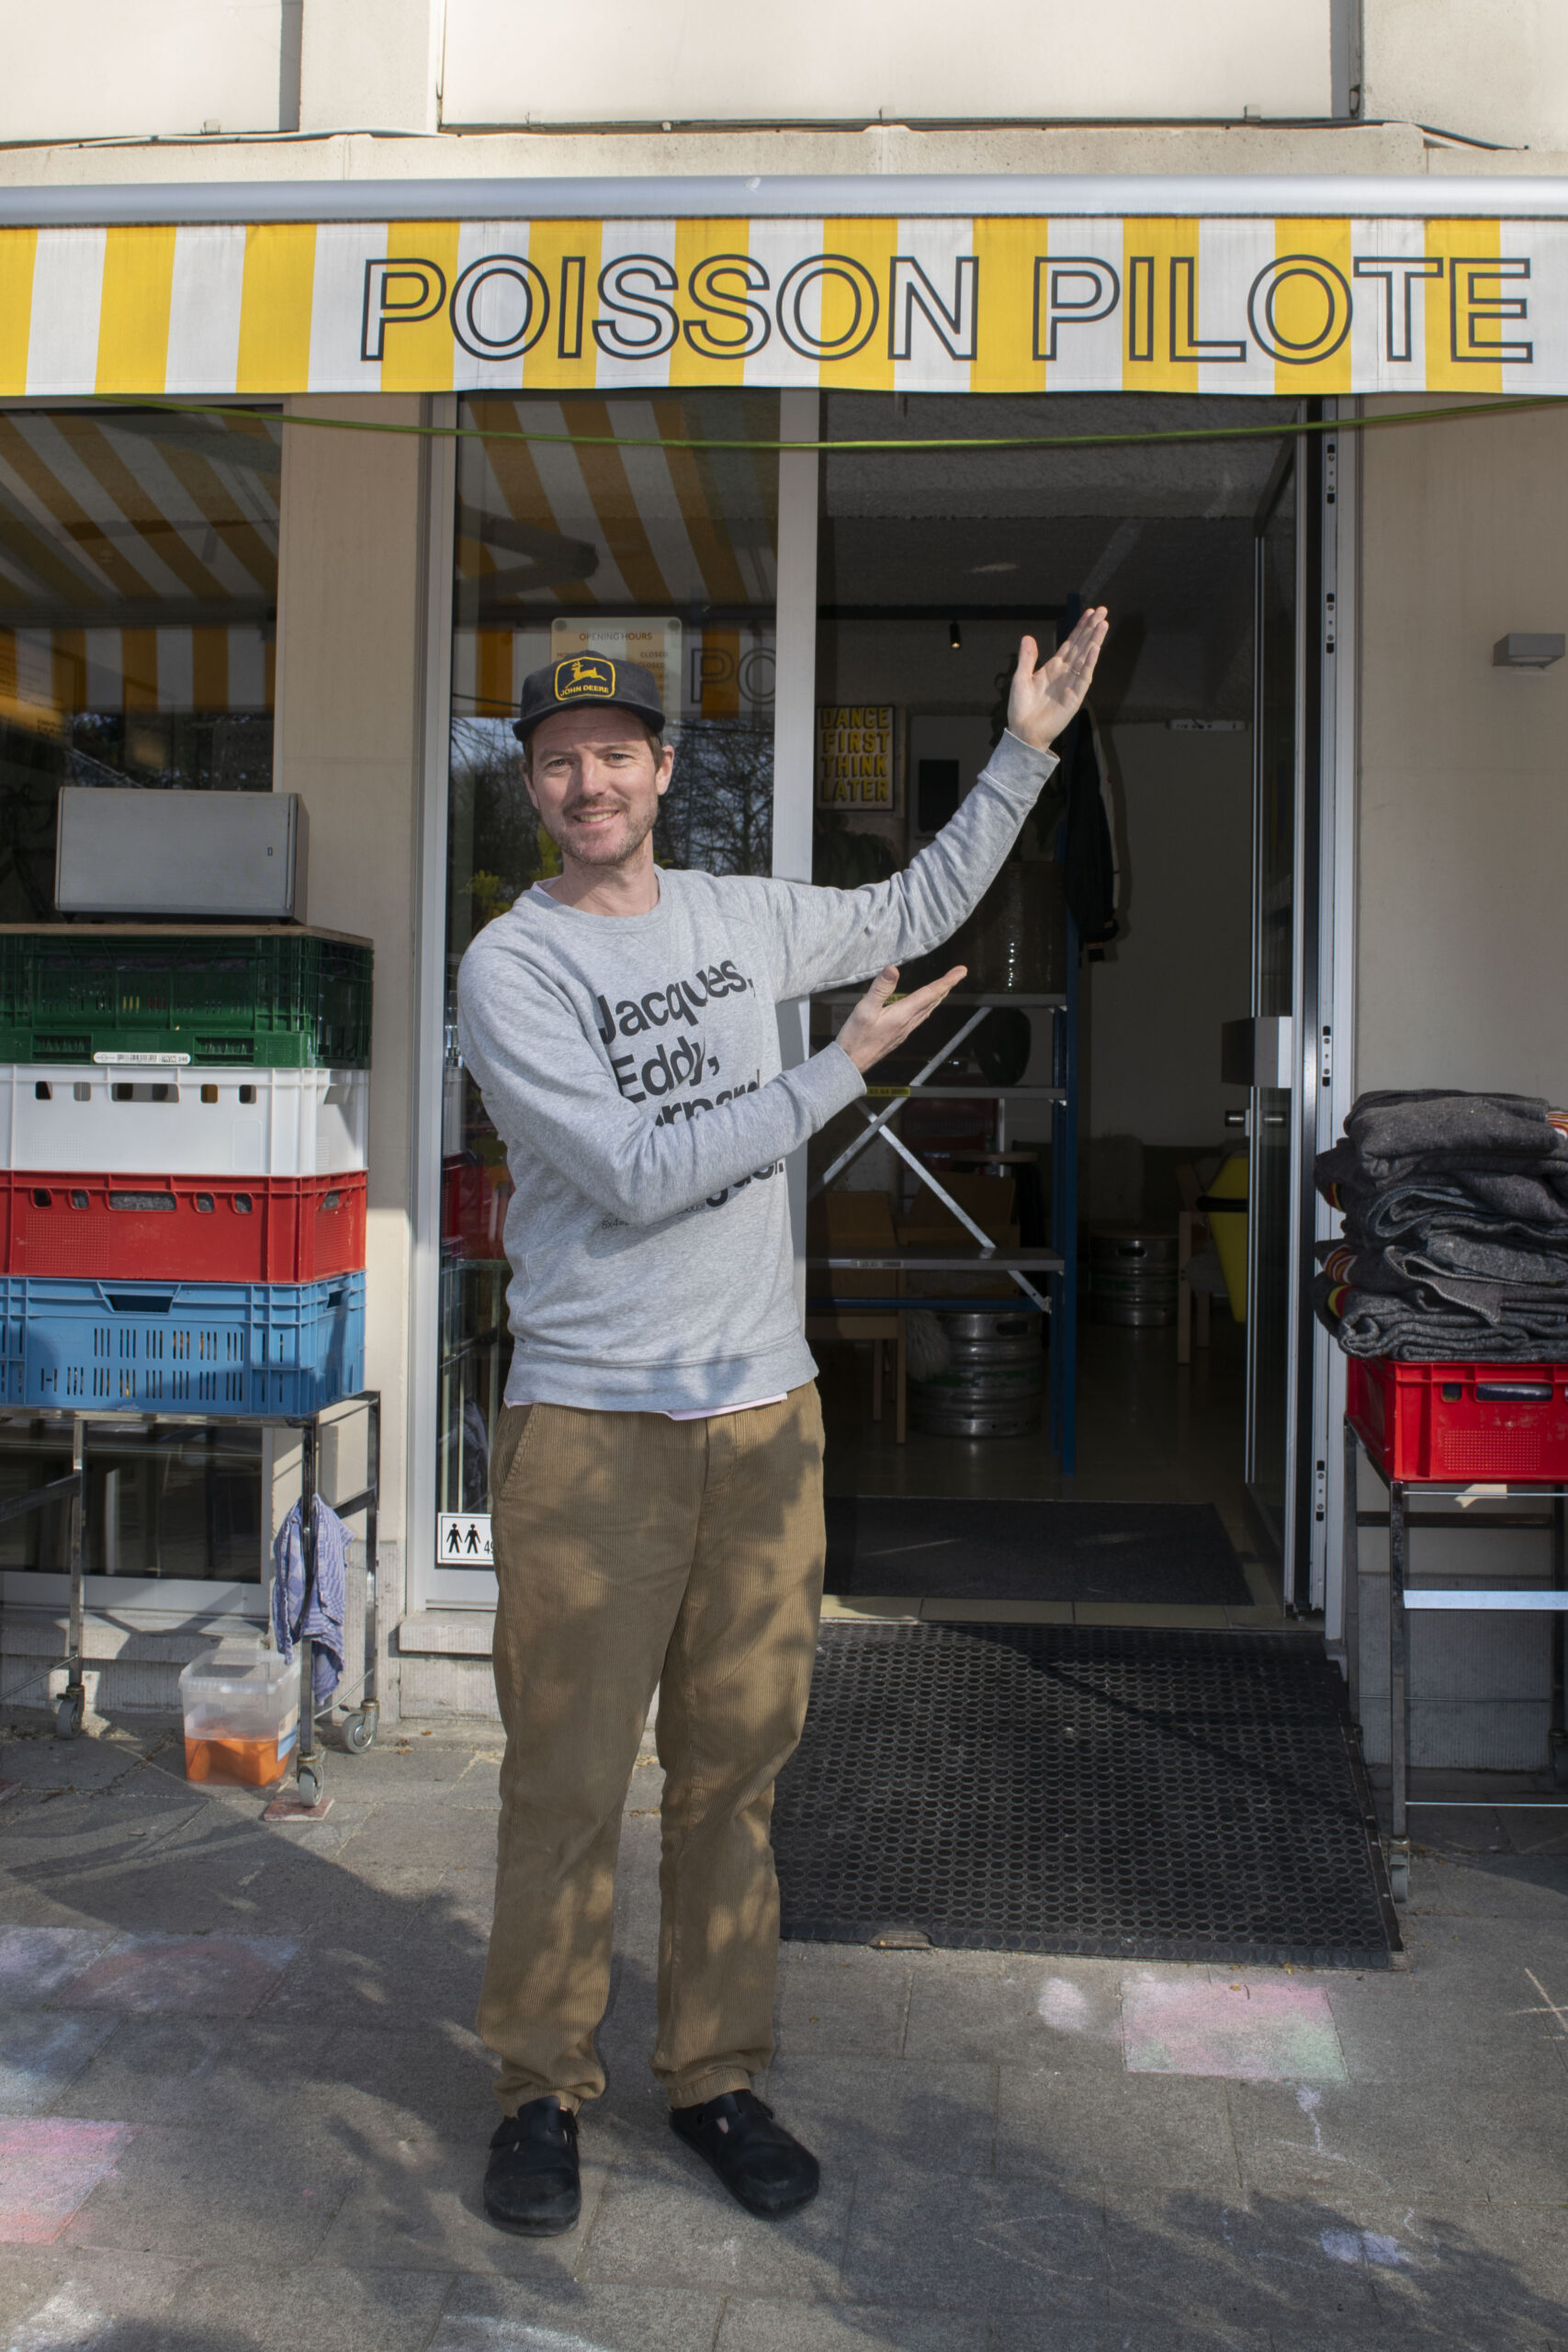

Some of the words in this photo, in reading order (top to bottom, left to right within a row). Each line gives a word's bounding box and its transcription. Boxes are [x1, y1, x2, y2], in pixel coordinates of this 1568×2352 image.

[360, 254, 979, 362] POISSON
[1032, 254, 1534, 364] PILOTE
[579, 632, 619, 641] OPENING
[621, 632, 653, 641] HOURS
[559, 685, 581, 697] JOHN
[582, 684, 610, 694] DEERE
[821, 707, 890, 729] DANCE
[822, 730, 890, 753] FIRST
[821, 754, 889, 778] THINK
[820, 778, 889, 802] LATER
[597, 959, 756, 1046] Jacques,
[610, 1035, 720, 1103] Eddy,
